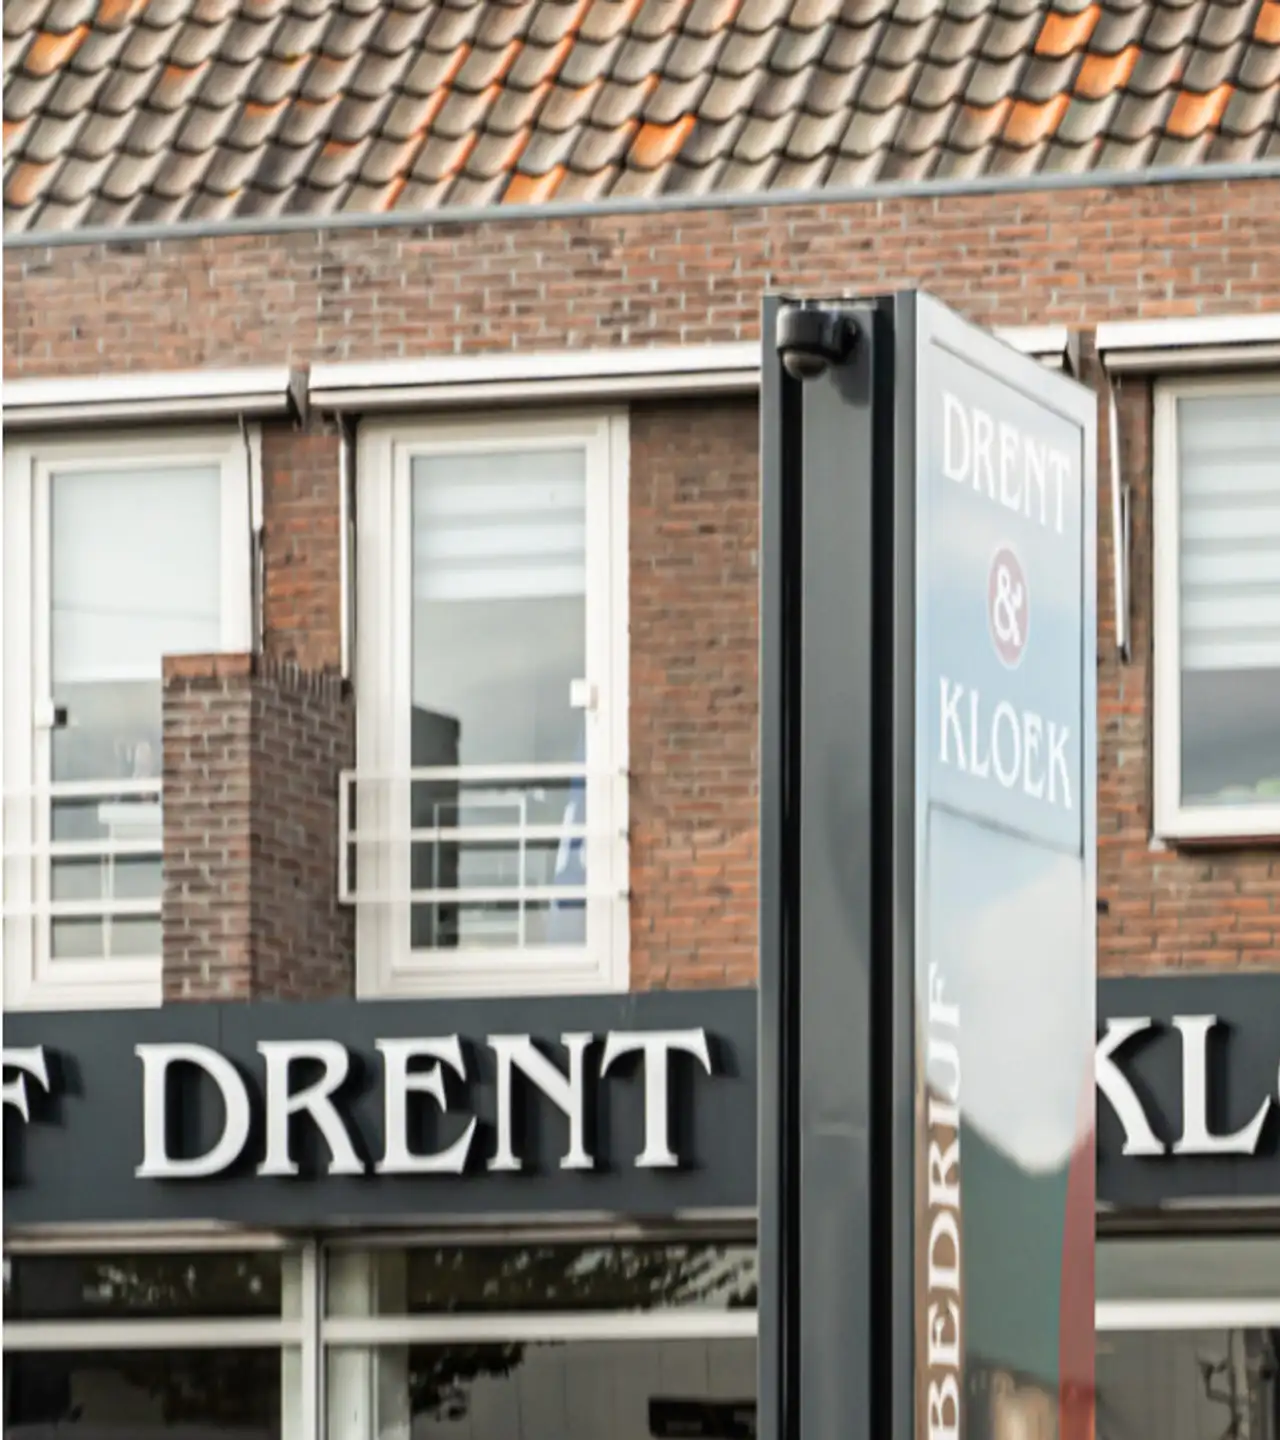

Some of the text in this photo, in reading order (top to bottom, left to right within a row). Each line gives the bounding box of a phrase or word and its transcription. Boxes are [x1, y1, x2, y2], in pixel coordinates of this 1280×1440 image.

[942, 388, 1071, 534] DRENT
[993, 564, 1023, 647] &
[939, 675, 1073, 811] KLOEK
[135, 1028, 712, 1178] DRENT
